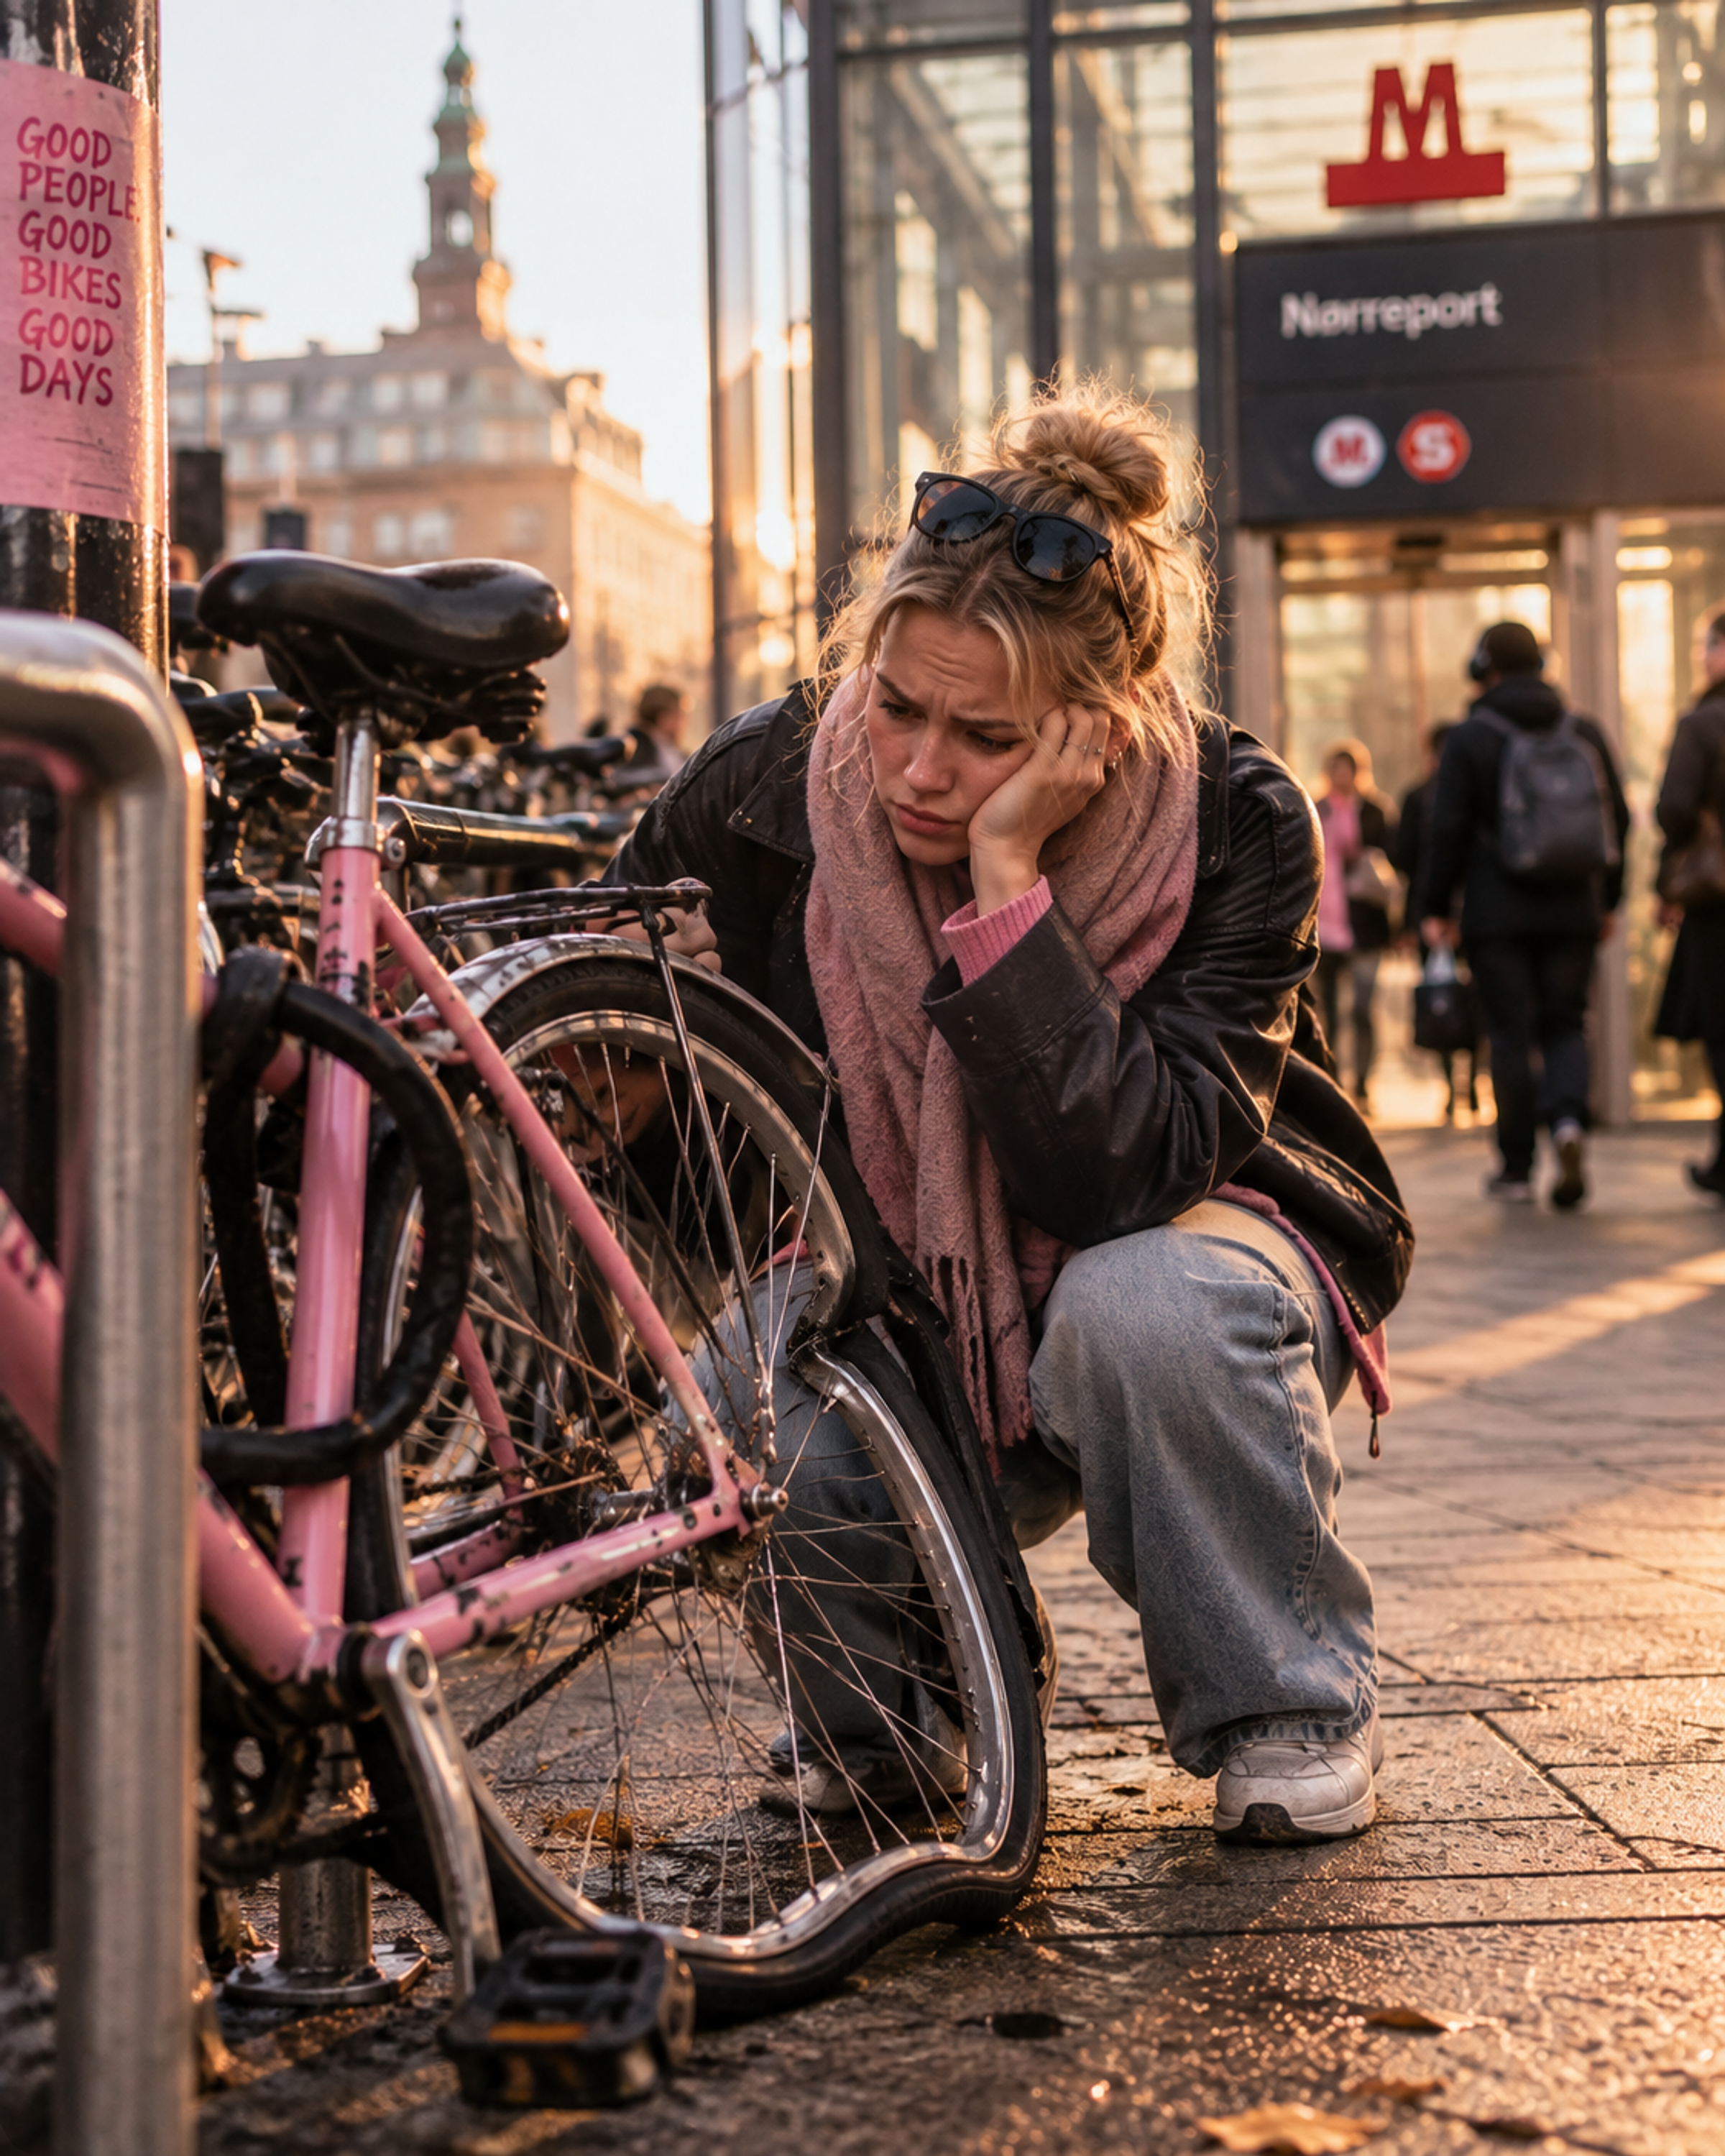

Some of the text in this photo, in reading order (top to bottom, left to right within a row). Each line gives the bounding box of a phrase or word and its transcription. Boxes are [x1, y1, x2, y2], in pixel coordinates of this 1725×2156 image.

[17, 117, 111, 168] GOOD
[18, 210, 111, 258] GOOD
[19, 256, 122, 310] BIKES
[18, 308, 114, 357] GOOD
[19, 354, 113, 406] DAYS
[1410, 423, 1457, 472] S
